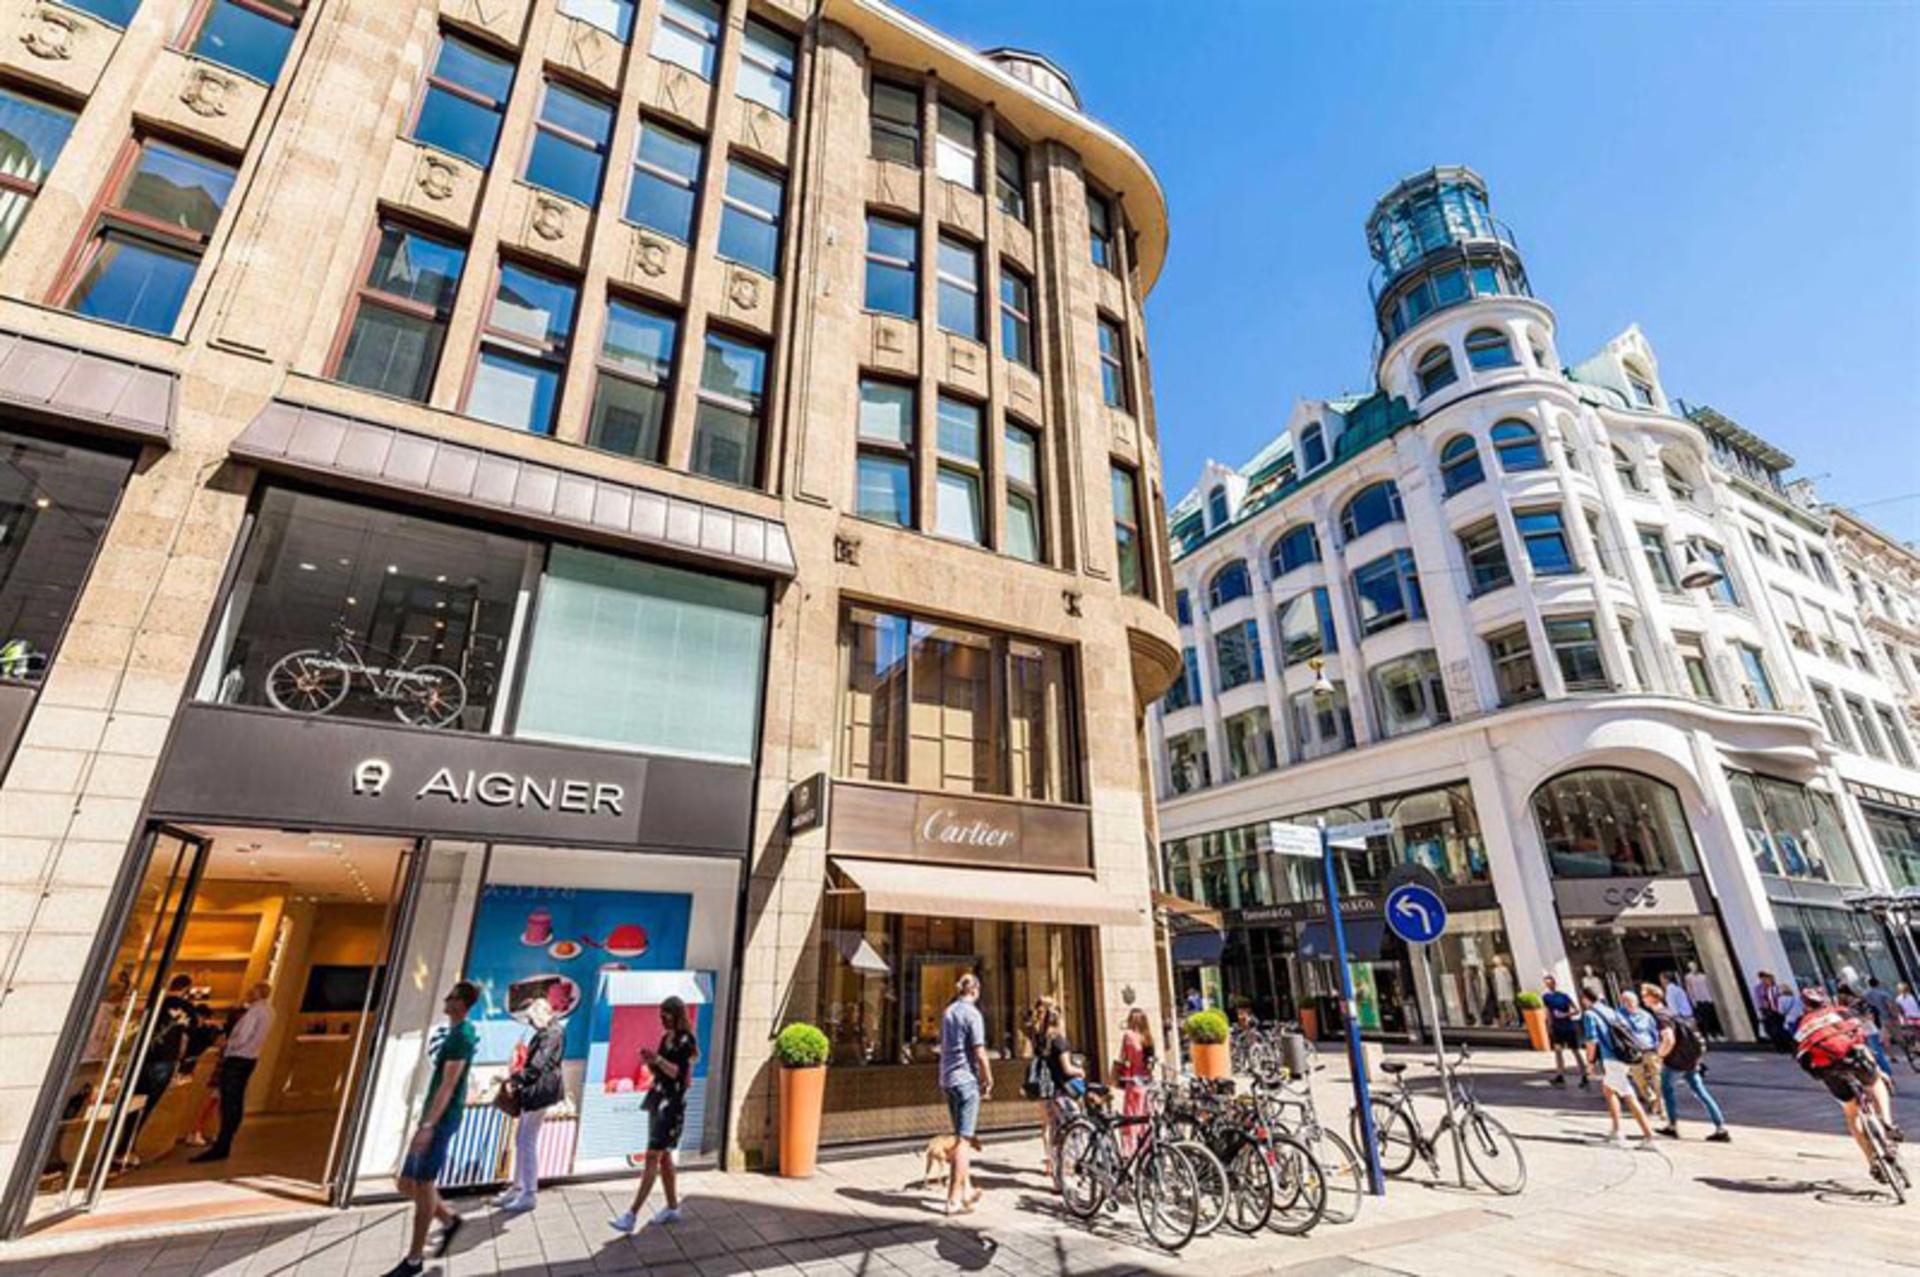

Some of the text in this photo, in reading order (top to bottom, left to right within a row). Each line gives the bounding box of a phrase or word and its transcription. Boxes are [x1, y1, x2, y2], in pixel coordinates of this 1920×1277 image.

[416, 766, 625, 815] AIGNER
[922, 808, 1014, 847] Cartier
[1602, 886, 1658, 909] COS
